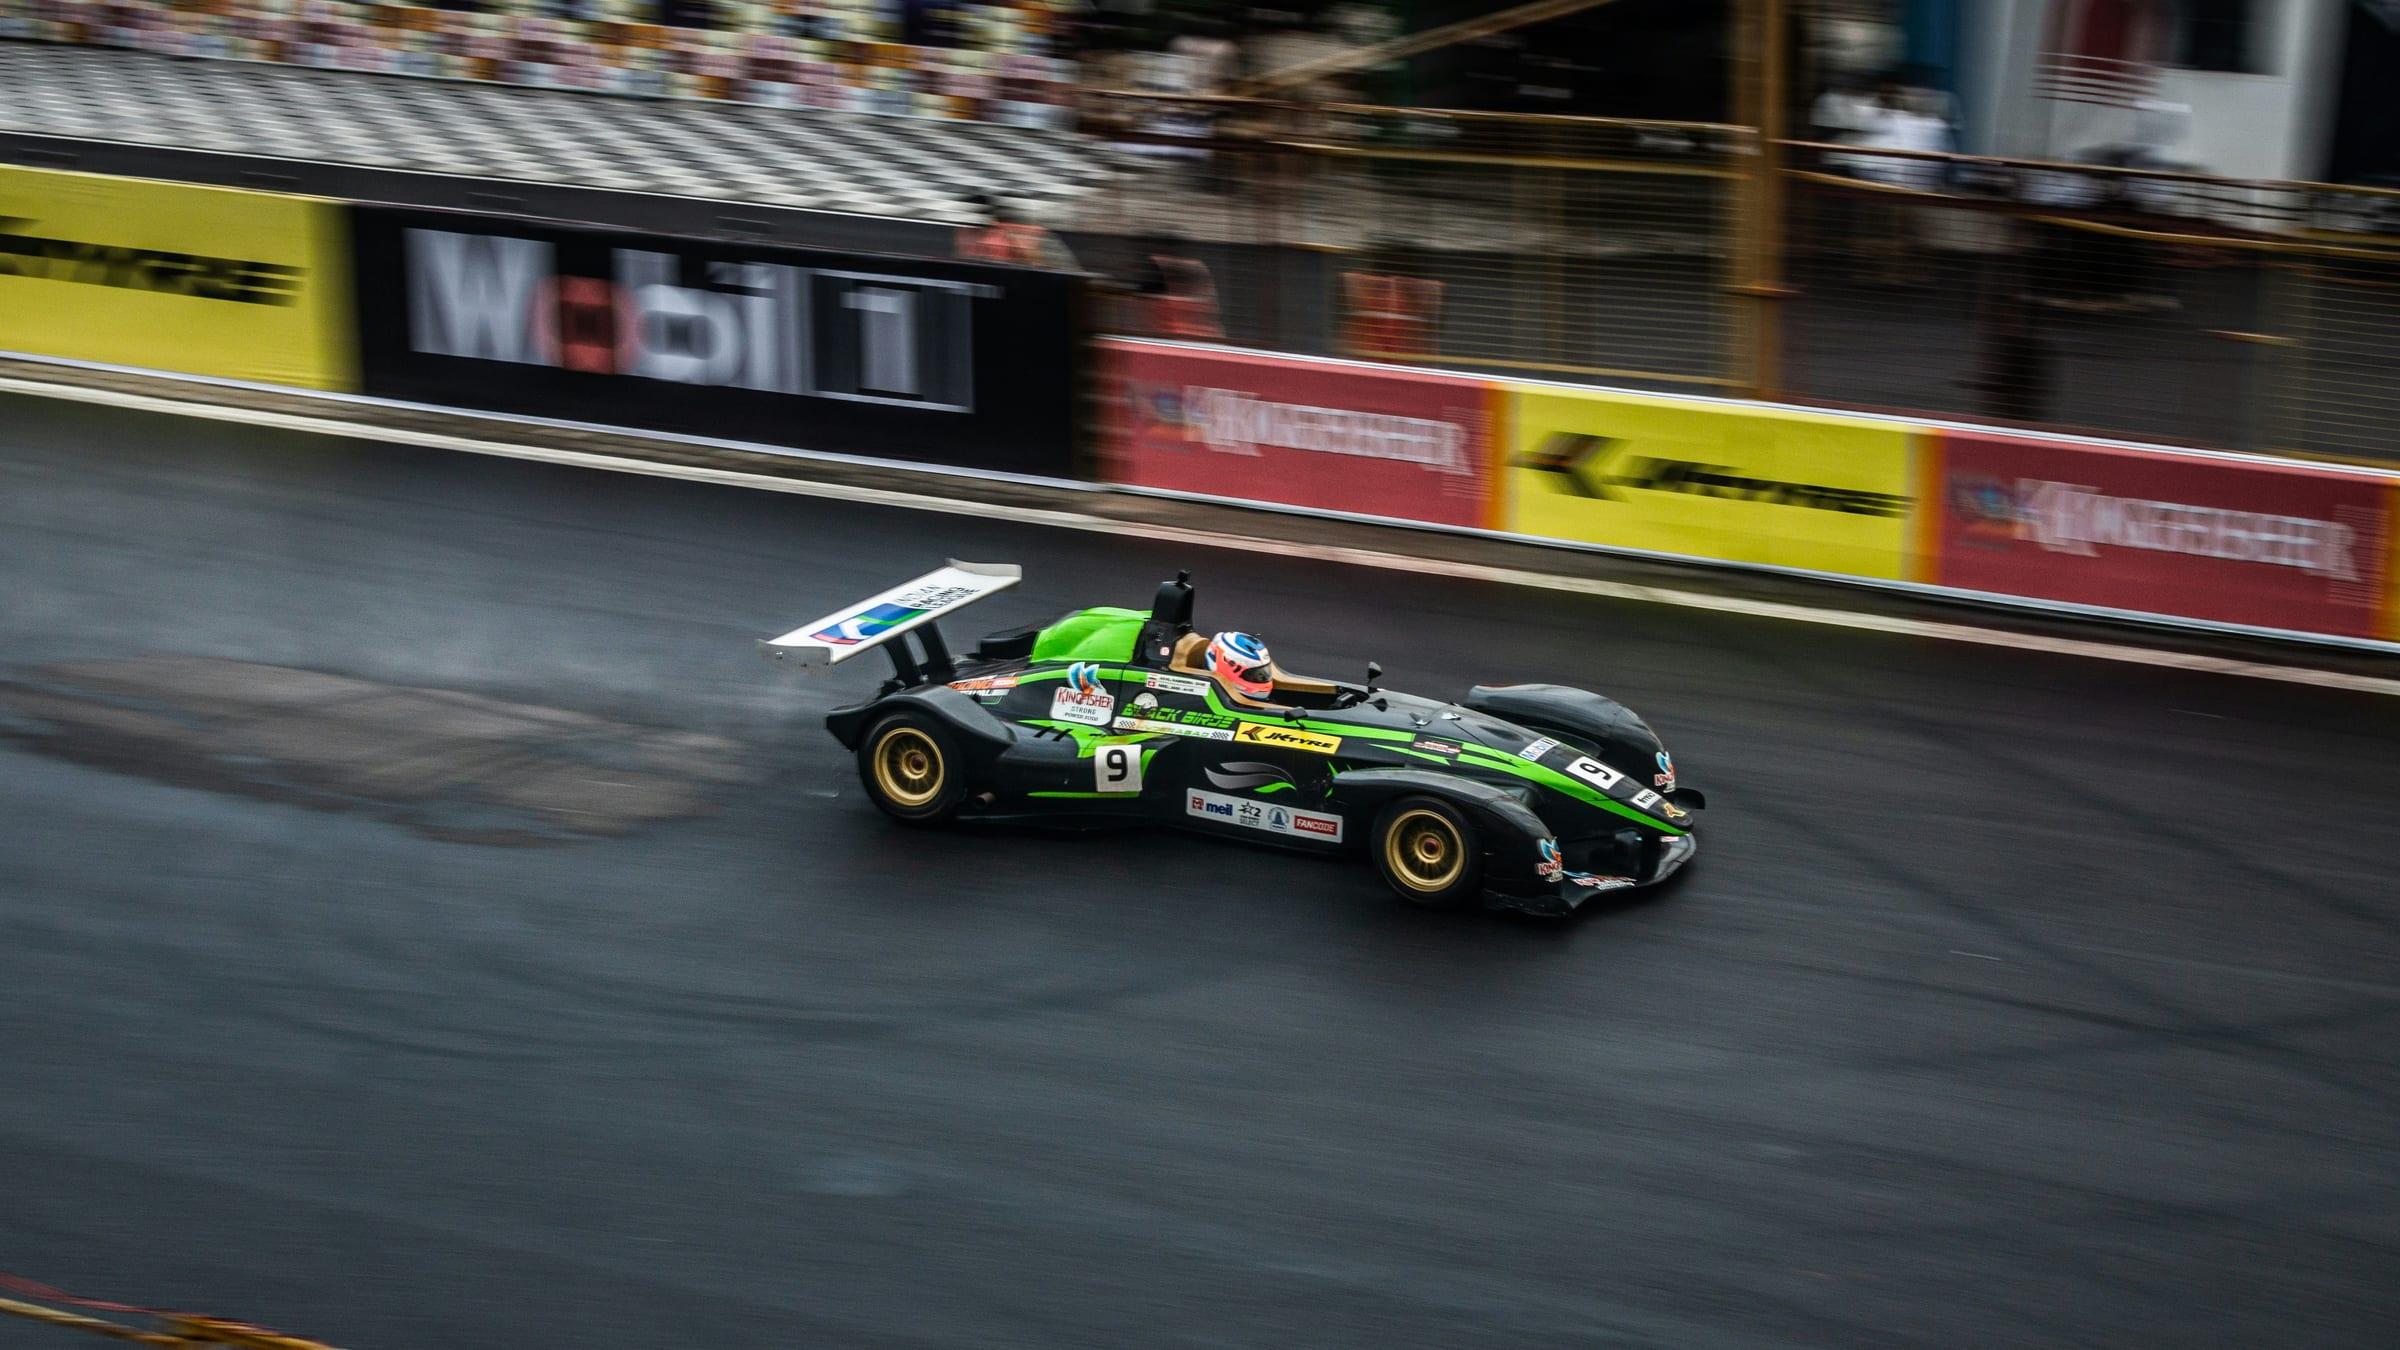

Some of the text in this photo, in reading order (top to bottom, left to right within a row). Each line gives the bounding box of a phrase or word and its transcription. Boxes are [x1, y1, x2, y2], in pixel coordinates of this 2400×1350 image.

[403, 228, 812, 396] Mobil
[1056, 689, 1113, 710] KINGFISHER
[1071, 706, 1097, 715] STRONG
[1119, 703, 1182, 722] BACK
[1106, 750, 1129, 783] 9
[1579, 763, 1612, 781] 9
[1655, 773, 1674, 786] KING
[1205, 801, 1233, 816] meil
[1296, 818, 1336, 832] FANCODE
